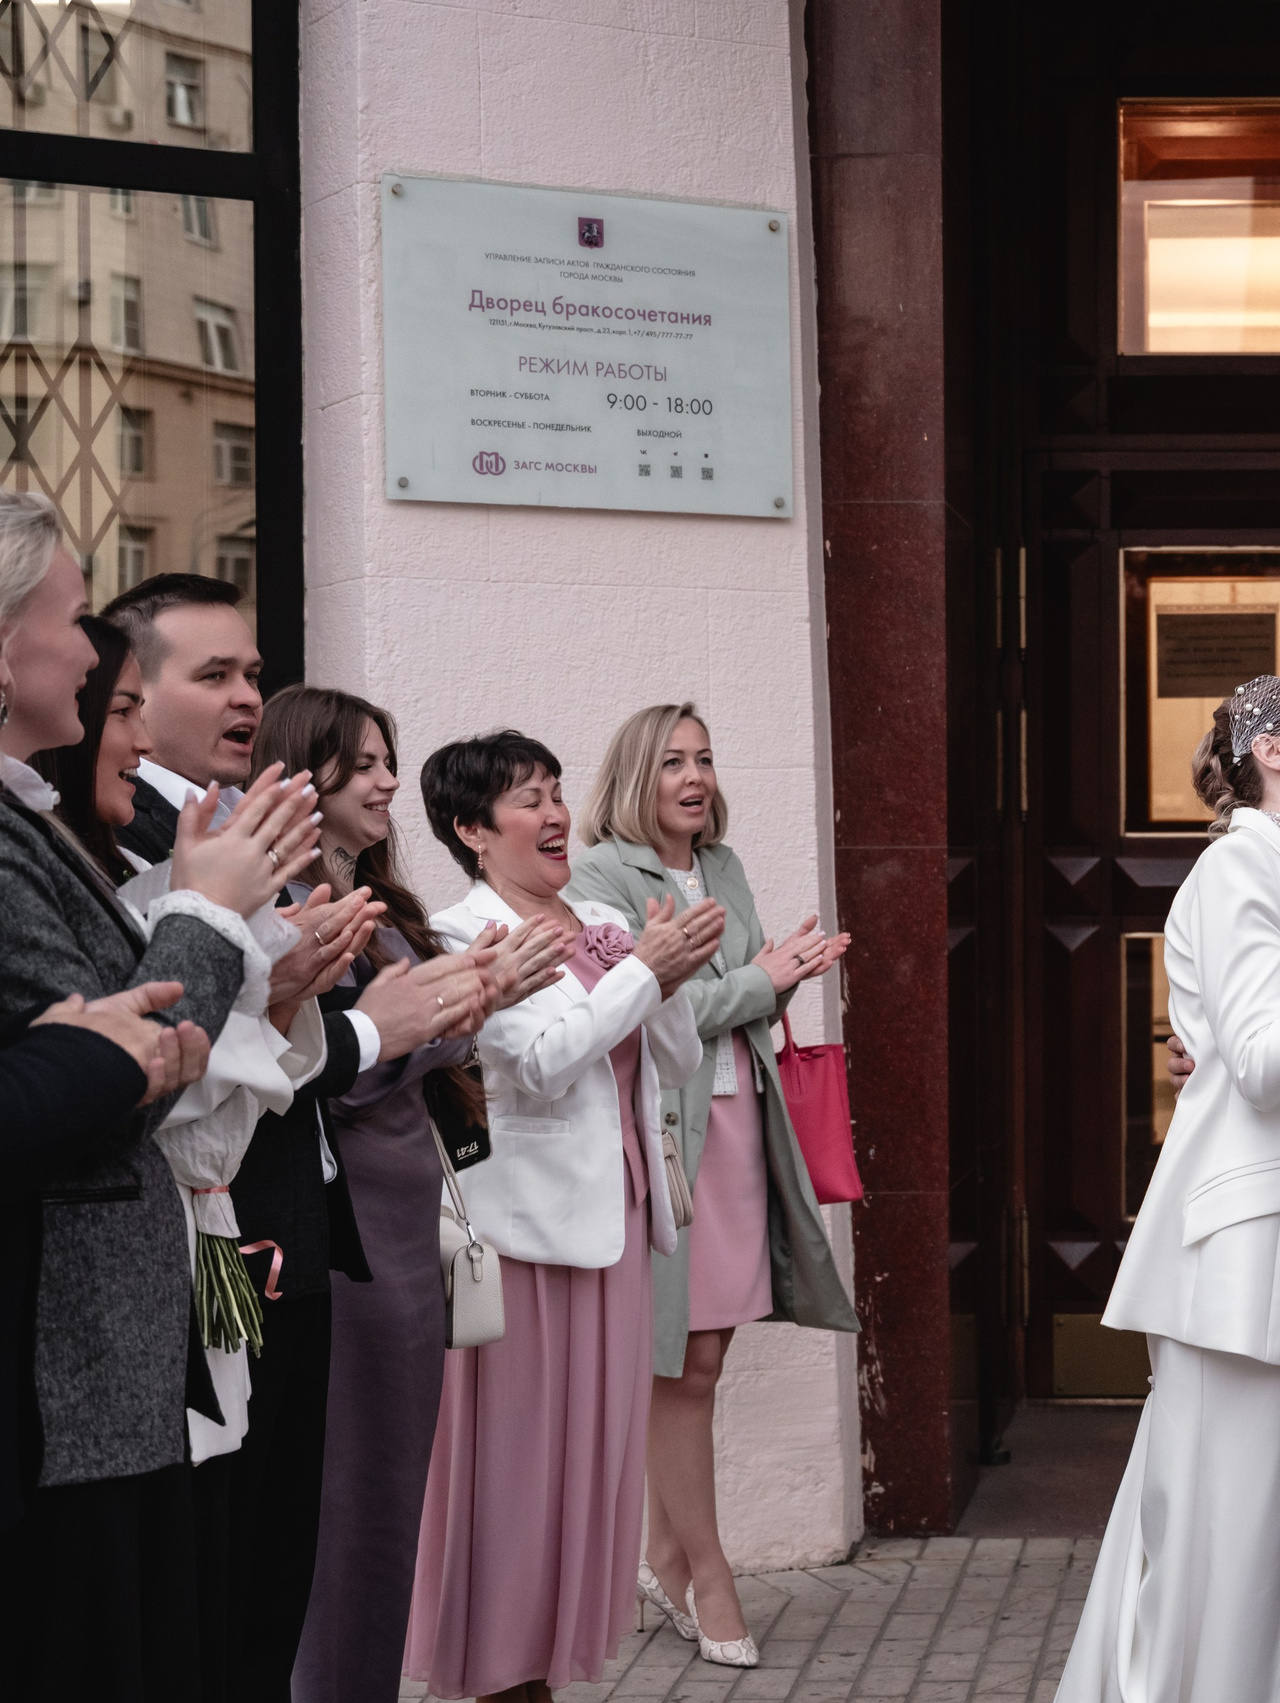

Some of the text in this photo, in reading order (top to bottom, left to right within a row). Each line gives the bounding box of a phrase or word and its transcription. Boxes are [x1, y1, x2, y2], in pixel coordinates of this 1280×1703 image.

[485, 253, 696, 277] УПРАВЛЕНИЕ ЗАПИСИ АКТОВ ГРАЖДАНСКОГО СОСТОЯНИЯ
[560, 271, 624, 283] ГОРОДА МОСКВЫ
[468, 289, 712, 326] Дворец бракосочетания
[518, 355, 667, 382] РЕЖИМ РАБОТЫ
[470, 389, 507, 399] ВТОРНИК
[514, 392, 550, 401] СУББОТА
[606, 393, 647, 411] 9:00
[666, 397, 713, 415] 18:00
[470, 418, 526, 429] ВОСКРЕСЕНЬЕ
[532, 421, 592, 432] ПОНЕДЕЛЬНИК
[636, 428, 682, 439] ВЫХОДНОЙ
[514, 460, 598, 474] ЗАГС МОСКВЫ
